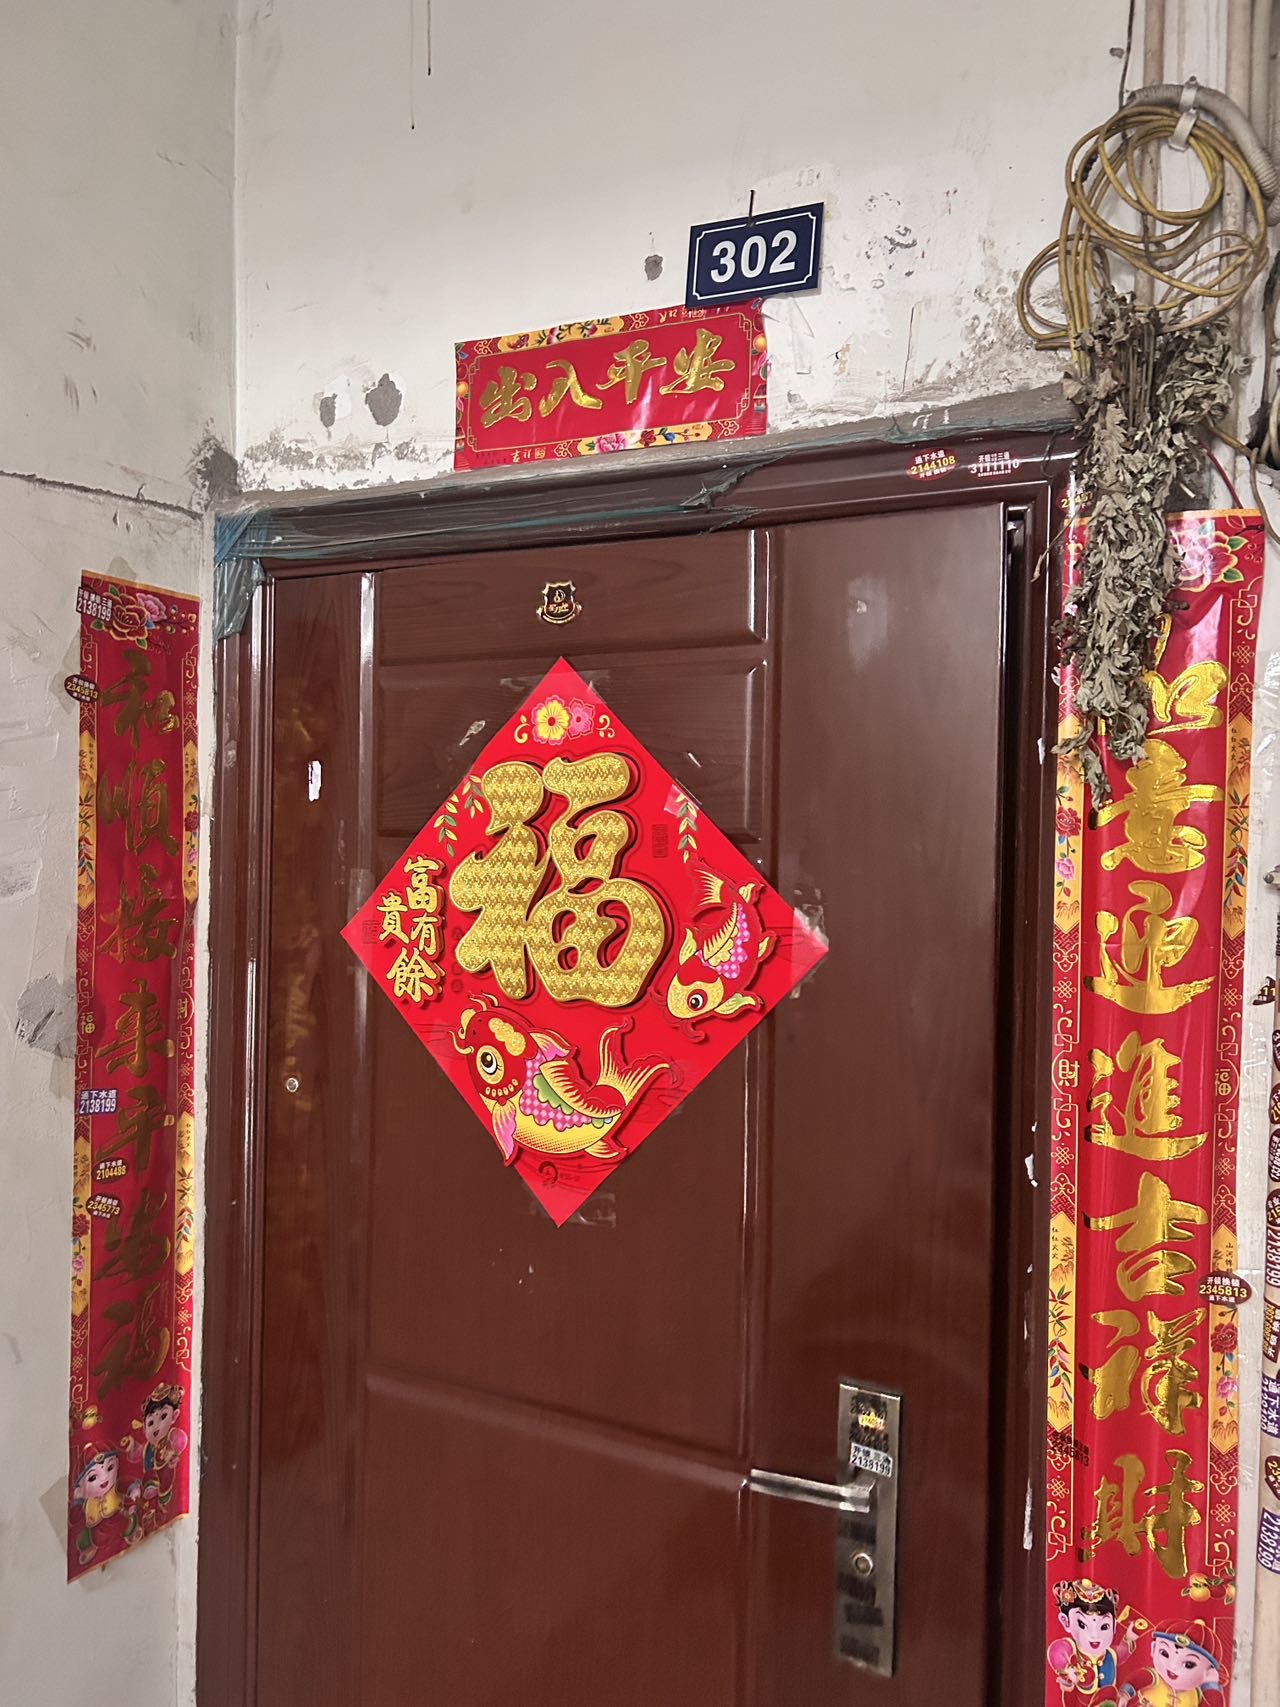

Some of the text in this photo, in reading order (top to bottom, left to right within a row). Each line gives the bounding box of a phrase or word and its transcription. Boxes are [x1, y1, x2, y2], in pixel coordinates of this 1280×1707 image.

[711, 230, 796, 283] 302
[480, 329, 735, 428] 出入平安
[911, 456, 955, 474] 2144108
[77, 597, 111, 621] 2138199
[67, 682, 98, 699] 2345813
[448, 752, 664, 1008] 福
[1215, 1069, 1231, 1096] 福
[80, 1099, 116, 1113] 2138199
[81, 1090, 117, 1101] 通下水道
[88, 1201, 120, 1215] 2345773
[1267, 1229, 1280, 1287] 2138199
[1199, 1285, 1247, 1297] 2345813
[851, 1454, 890, 1475] 2138199
[1258, 1511, 1280, 1568] 2138199
